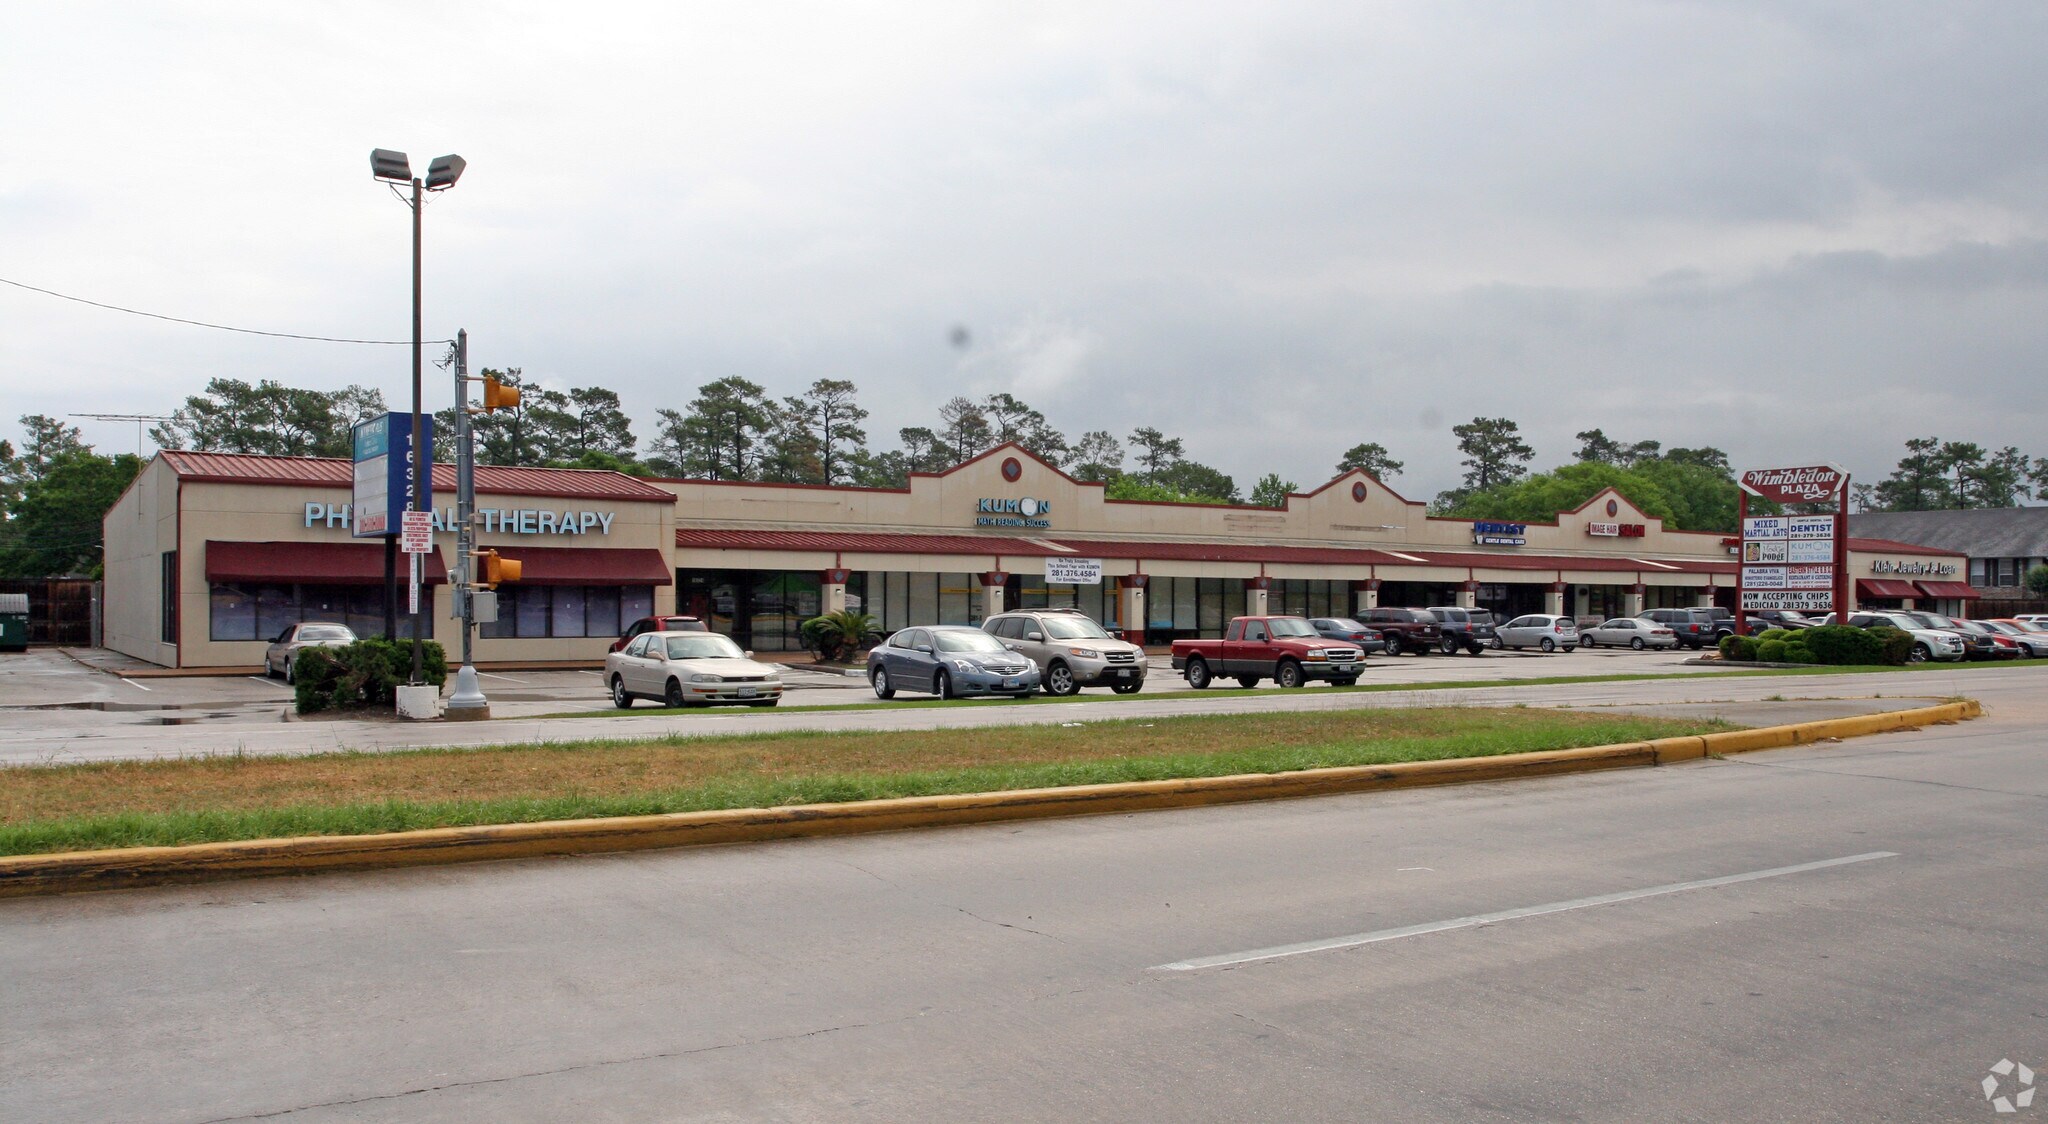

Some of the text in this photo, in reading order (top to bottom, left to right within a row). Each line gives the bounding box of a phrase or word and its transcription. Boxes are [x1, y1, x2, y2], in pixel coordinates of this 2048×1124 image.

[1748, 468, 1836, 486] Wimbledon
[1781, 484, 1820, 494] PLAZA
[979, 497, 1050, 517] KUMON
[480, 507, 615, 534] THERAPY
[1754, 520, 1778, 528] MIXED
[1474, 522, 1526, 535] DENTIST
[1591, 524, 1606, 533] IMAGE
[1606, 524, 1617, 534] HAIR
[1745, 528, 1787, 537] MARTIAL ARTS
[1791, 524, 1832, 532] DENTIST
[1791, 542, 1831, 550] KUMON
[1874, 560, 1894, 573] Klein
[1898, 561, 1926, 575] Jewelry
[1938, 562, 1956, 574] Loan
[1762, 592, 1803, 600] ACCEPTING
[1806, 592, 1829, 600] CHIPS
[1743, 601, 1779, 609] MEDICIAD
[1812, 601, 1832, 609] 3636
